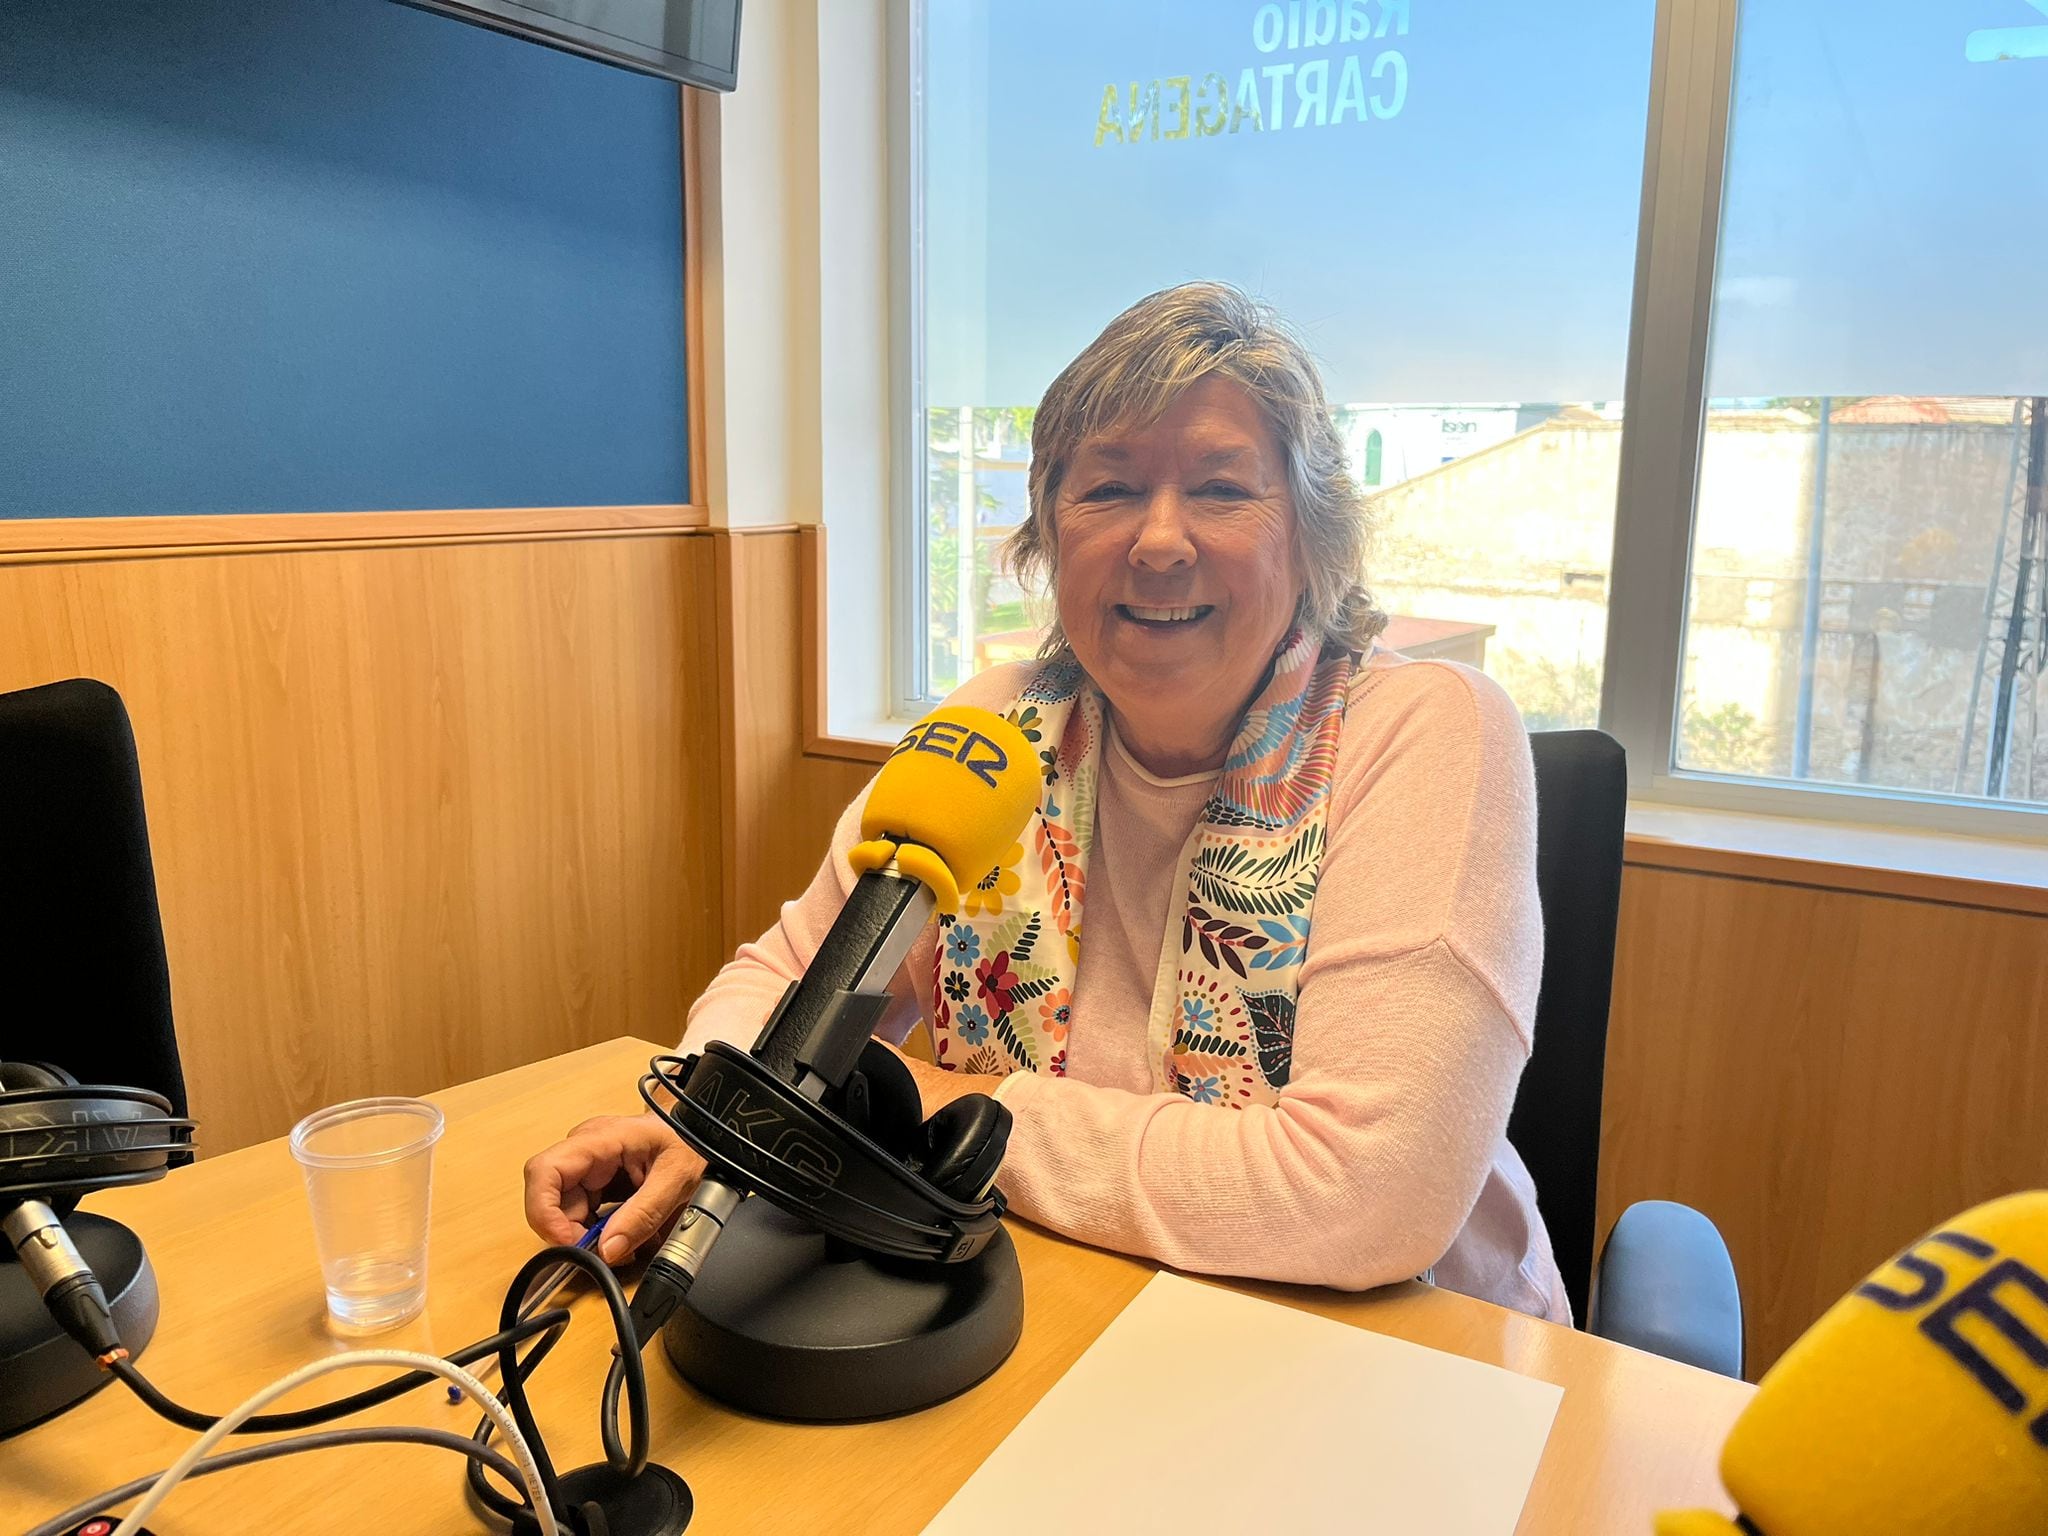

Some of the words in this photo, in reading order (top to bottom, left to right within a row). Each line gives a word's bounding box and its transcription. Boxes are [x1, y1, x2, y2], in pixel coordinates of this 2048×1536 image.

[888, 721, 1008, 789] SER
[692, 1070, 843, 1201] AKG
[1856, 1230, 2048, 1450] SE
